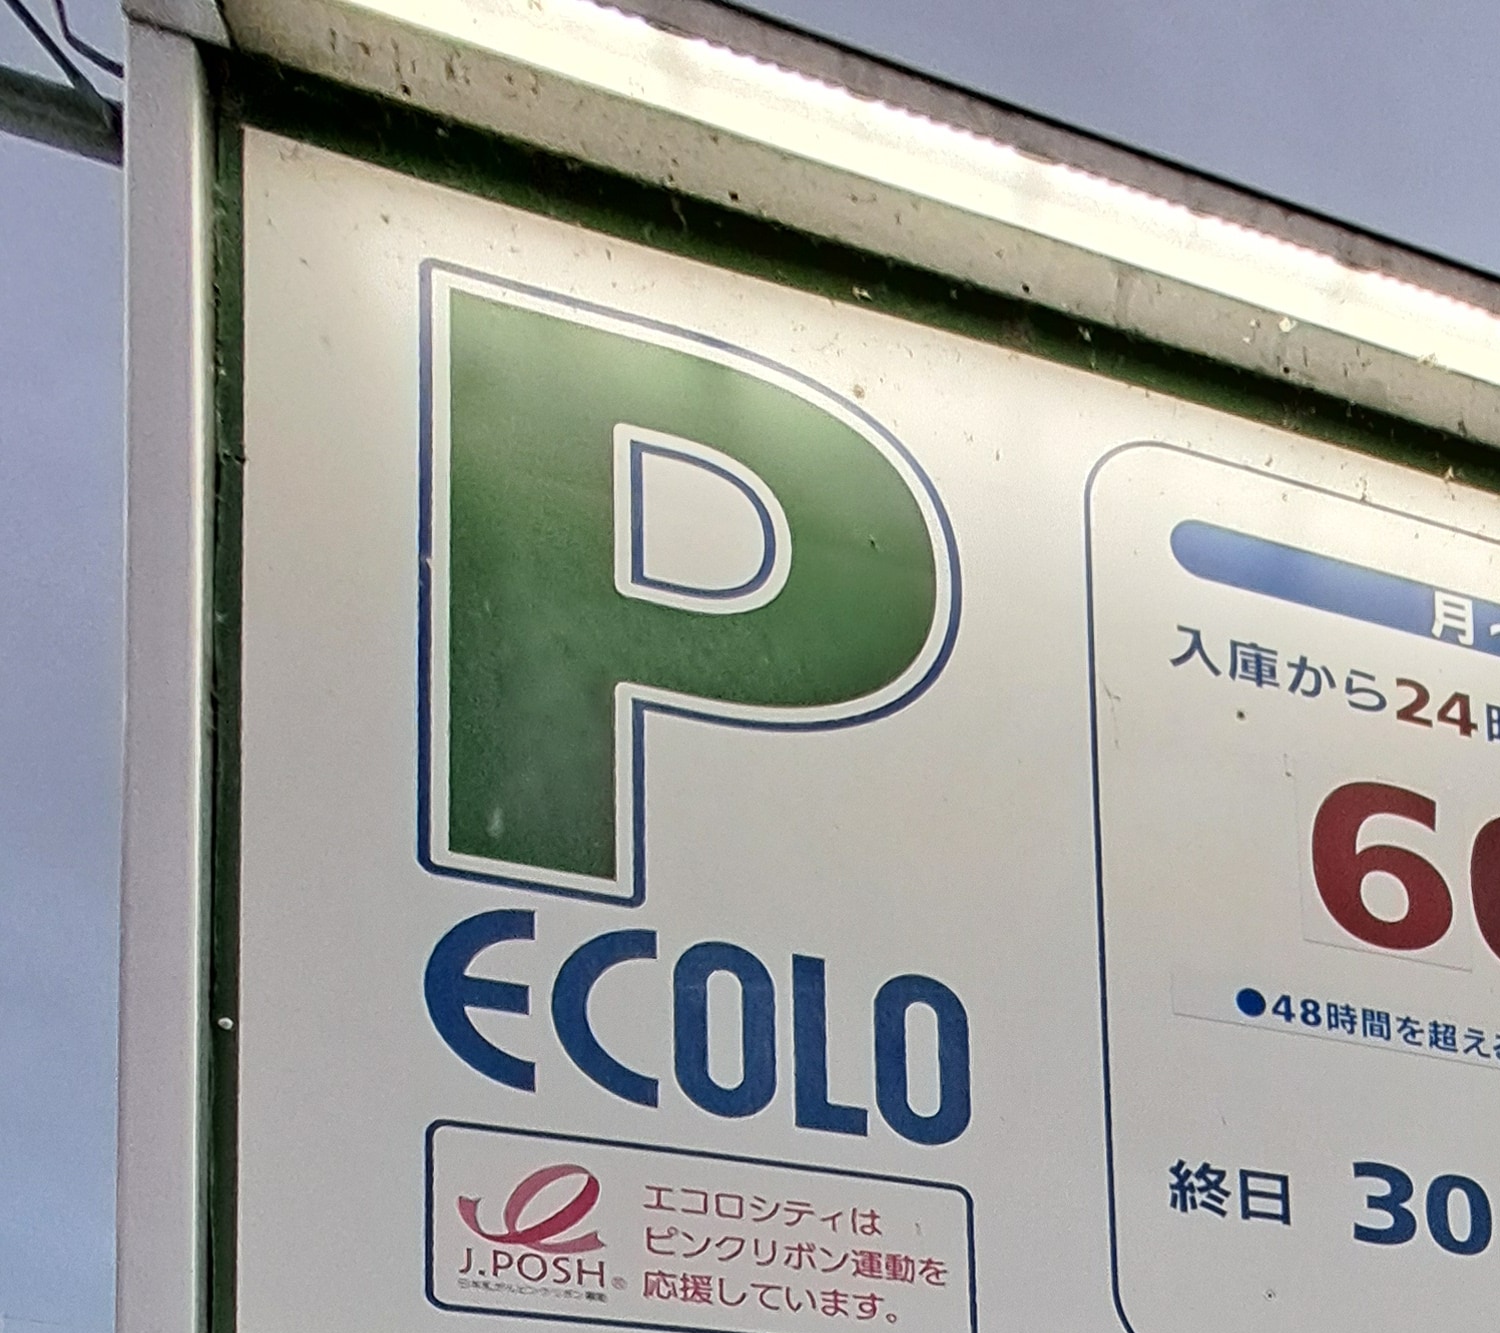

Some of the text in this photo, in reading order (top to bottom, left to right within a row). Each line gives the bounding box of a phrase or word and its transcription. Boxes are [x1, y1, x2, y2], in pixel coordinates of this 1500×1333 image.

[418, 258, 962, 904] P
[423, 908, 972, 1146] ECOLO
[642, 1186, 882, 1236] エコロシティは
[1168, 1158, 1292, 1227] 終日
[643, 1226, 948, 1288] ピンクリボン運動を
[641, 1270, 900, 1324] 応援しています。
